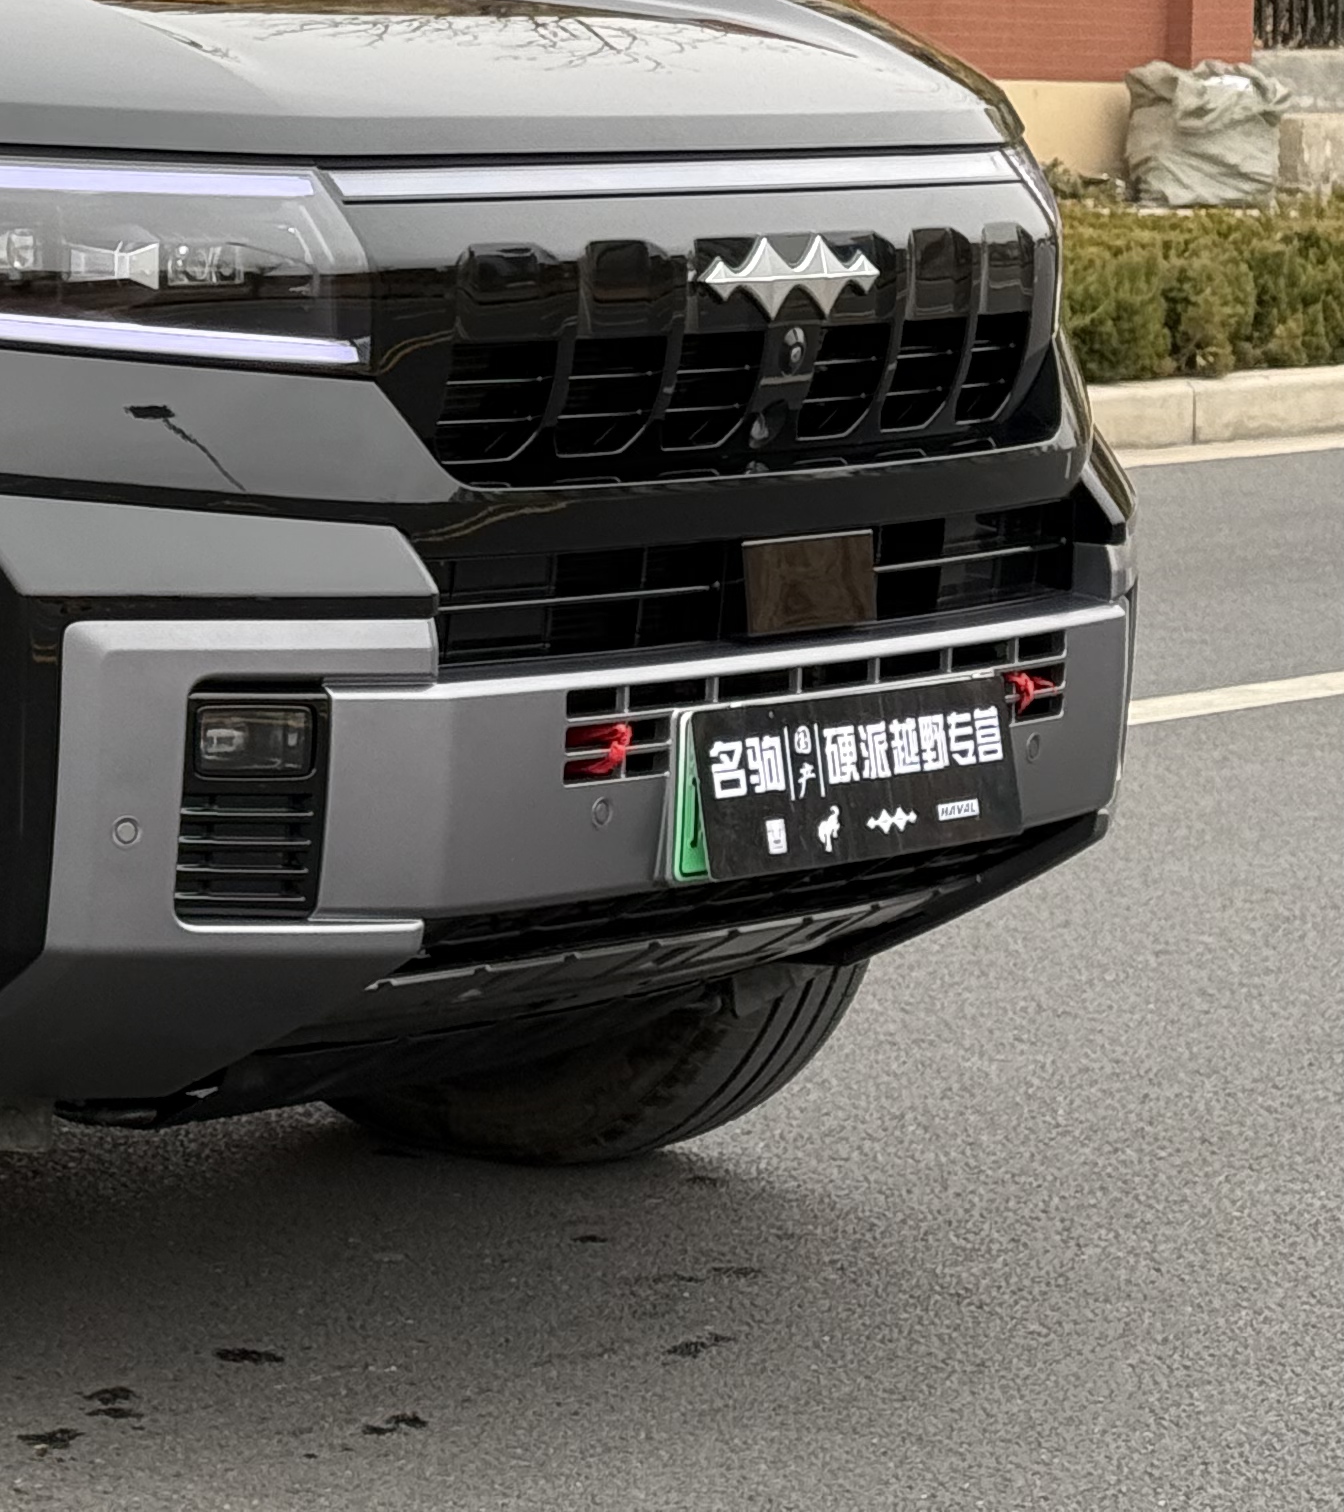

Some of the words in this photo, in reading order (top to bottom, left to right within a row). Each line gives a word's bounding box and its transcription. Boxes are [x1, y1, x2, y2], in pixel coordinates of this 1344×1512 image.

[709, 735, 786, 799] 名驹
[823, 705, 1003, 785] 硬派越野专营
[940, 800, 977, 818] HAVAL
